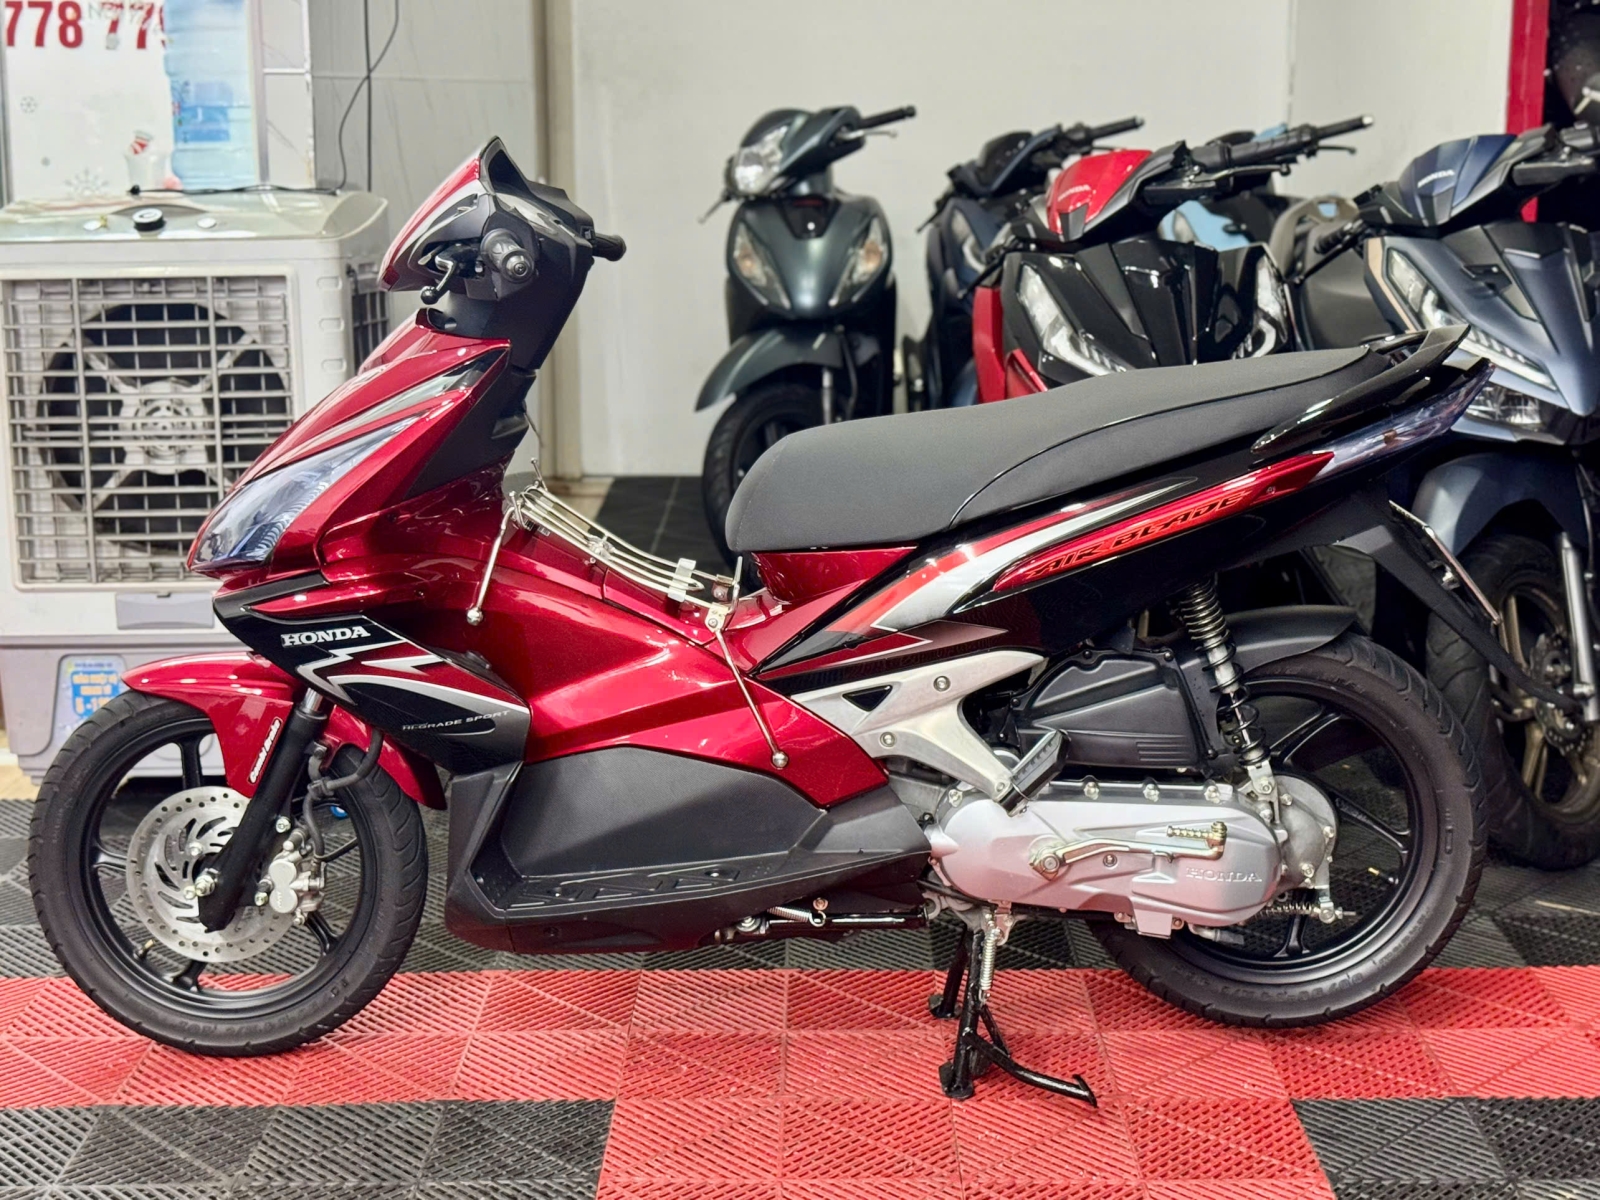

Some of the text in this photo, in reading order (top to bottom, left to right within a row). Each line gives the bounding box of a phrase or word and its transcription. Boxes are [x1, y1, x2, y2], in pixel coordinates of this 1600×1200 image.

[5, 1, 83, 48] 778
[101, 1, 166, 49] 77
[1025, 489, 1252, 579] AIR BLADE
[280, 625, 371, 648] HONDA
[465, 710, 511, 723] SPORT
[1185, 867, 1263, 882] HONDA
